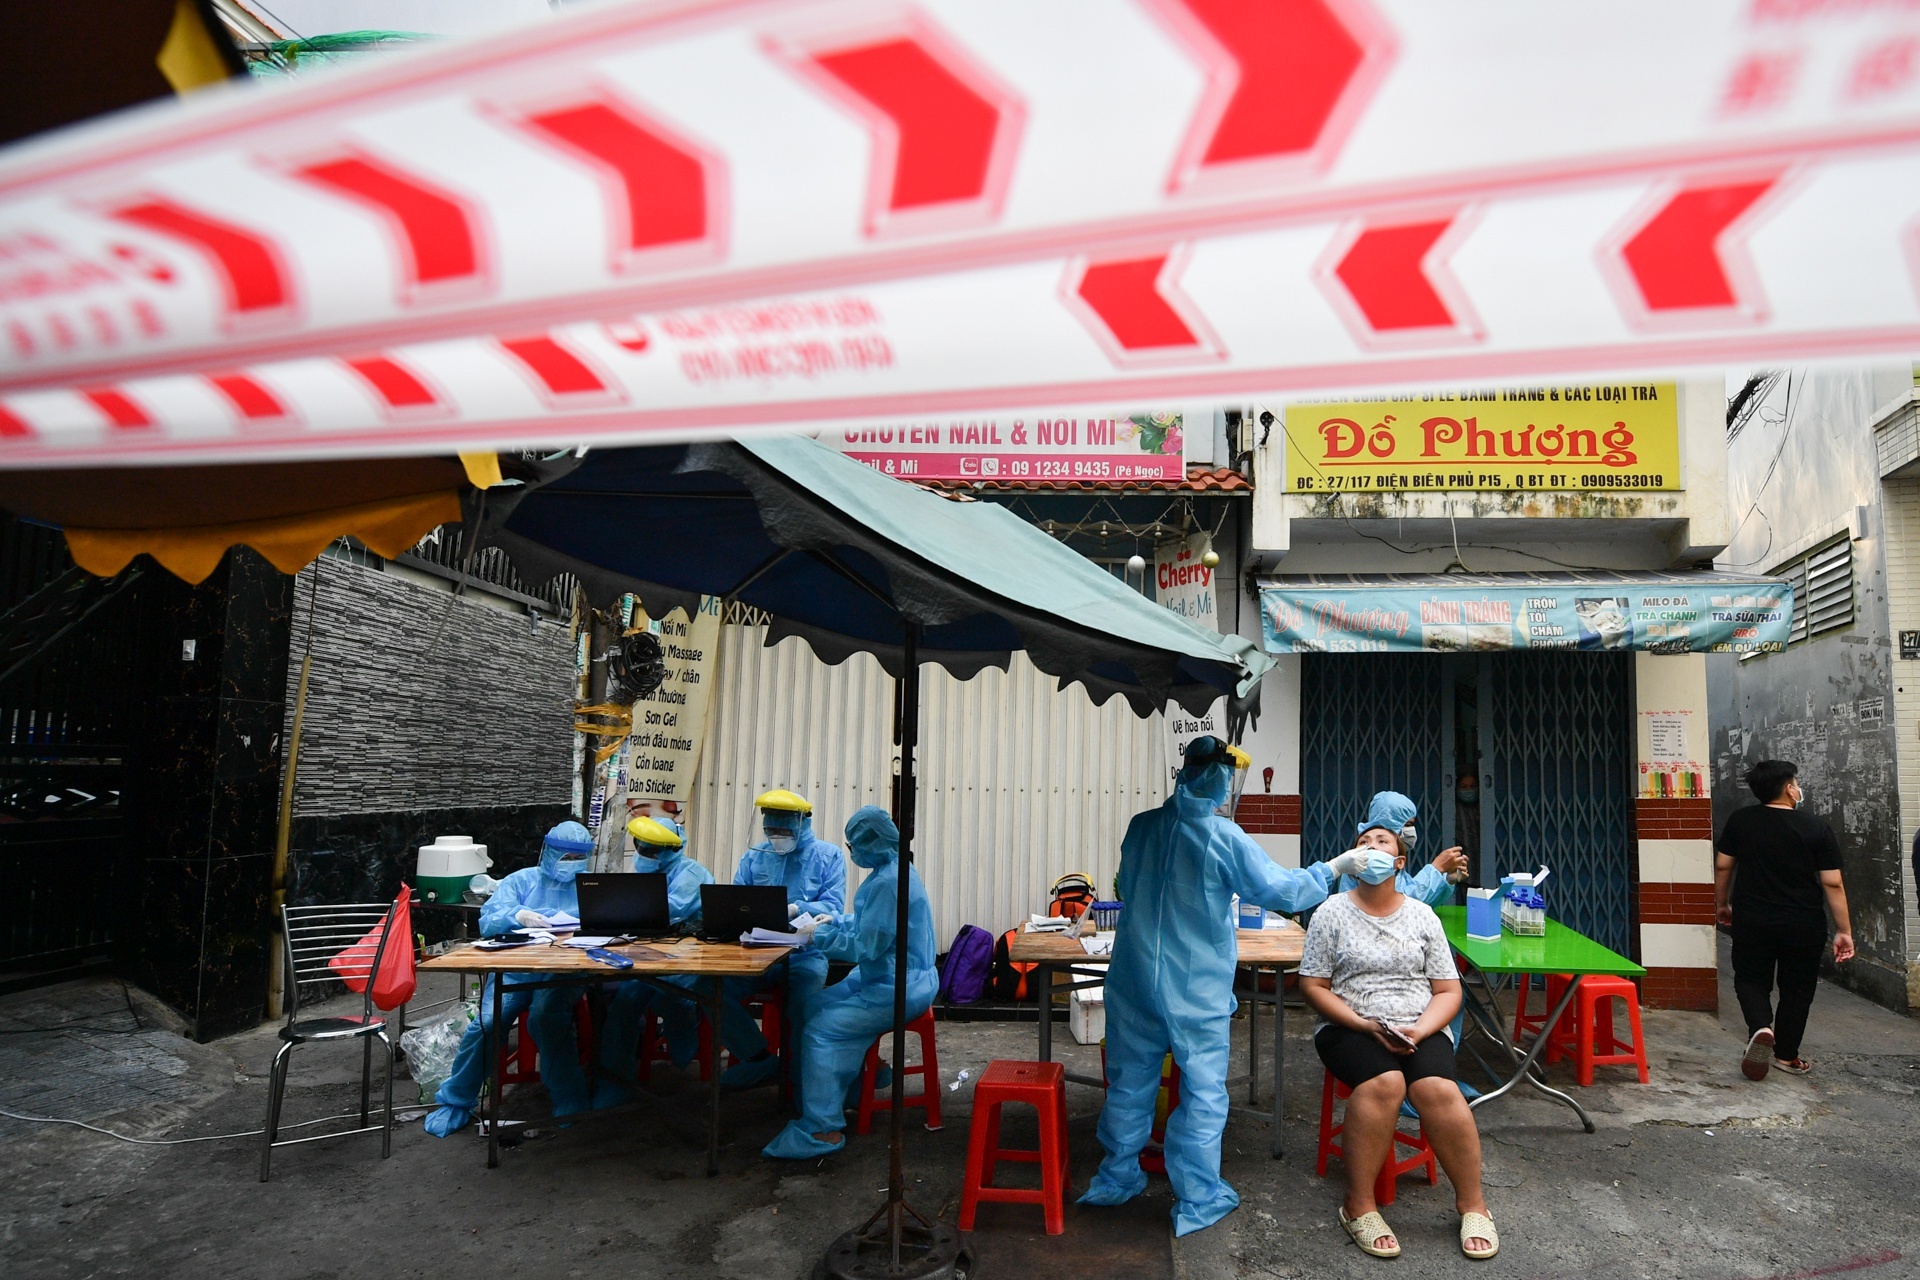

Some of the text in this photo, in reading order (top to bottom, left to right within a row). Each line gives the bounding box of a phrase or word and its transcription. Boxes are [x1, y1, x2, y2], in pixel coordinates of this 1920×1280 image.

[1550, 386, 1559, 402] &
[1596, 386, 1627, 404] LOẠI
[1632, 382, 1658, 401] TRÀ
[949, 418, 1001, 444] NAIL
[1010, 418, 1028, 445] &
[1087, 418, 1115, 446] MI
[1420, 416, 1638, 467] Phượng
[857, 458, 919, 475] ail & Mi
[1011, 460, 1029, 475] 09
[1035, 460, 1070, 476] 1234
[1075, 461, 1110, 476] 9435
[1297, 477, 1314, 489] ĐC
[1327, 475, 1371, 489] 27/117
[1376, 473, 1408, 490] ĐIỆN
[1413, 472, 1444, 487] BIÊN
[1449, 471, 1474, 487] PHỦ
[1479, 474, 1501, 486] P15
[1515, 474, 1524, 488] Q
[1528, 474, 1544, 486] BT
[1550, 474, 1567, 486] ĐT
[1581, 474, 1663, 487] 0909533019
[1158, 561, 1211, 590] Cherry
[1197, 591, 1212, 618] Mi
[1527, 596, 1557, 611] TRỘN
[1642, 594, 1689, 606] MILO ĐÁ
[1420, 596, 1512, 624] BÁNH TRÁNG
[1636, 609, 1698, 621] TRÀ CHANH
[1712, 609, 1782, 623] TRÀ SỮA THÁI
[675, 622, 688, 638] Mi
[667, 644, 704, 662] Massage
[1330, 640, 1358, 652] 533
[1361, 639, 1388, 652] 019
[663, 668, 674, 681] ay
[681, 668, 700, 684] chân
[658, 684, 687, 705] thường
[645, 710, 678, 727] Sơn Gel
[1184, 719, 1198, 733] hoa
[629, 732, 651, 747] rench
[669, 735, 693, 751] móng
[651, 756, 675, 772] loang
[629, 778, 676, 795] Dán Sticker
